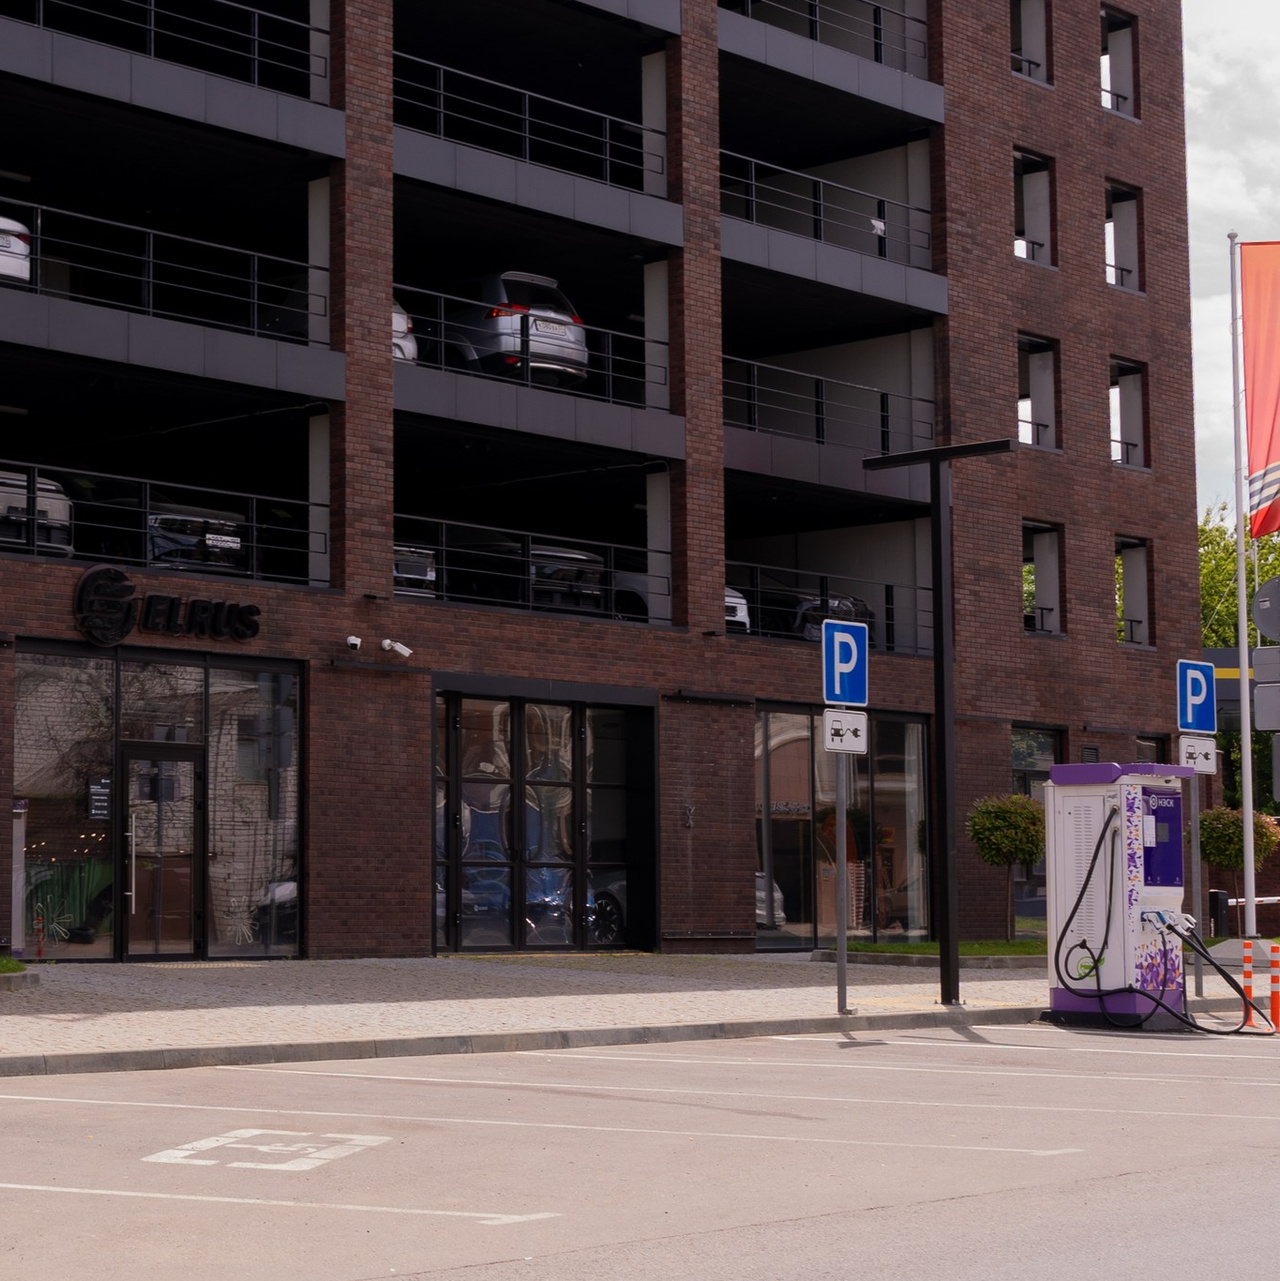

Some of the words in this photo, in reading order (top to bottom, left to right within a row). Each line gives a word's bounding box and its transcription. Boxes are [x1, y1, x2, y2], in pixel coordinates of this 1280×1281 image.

[140, 593, 261, 640] ELRUS
[834, 632, 857, 694] P
[1187, 670, 1206, 722] P
[1158, 798, 1175, 807] НЭСК
